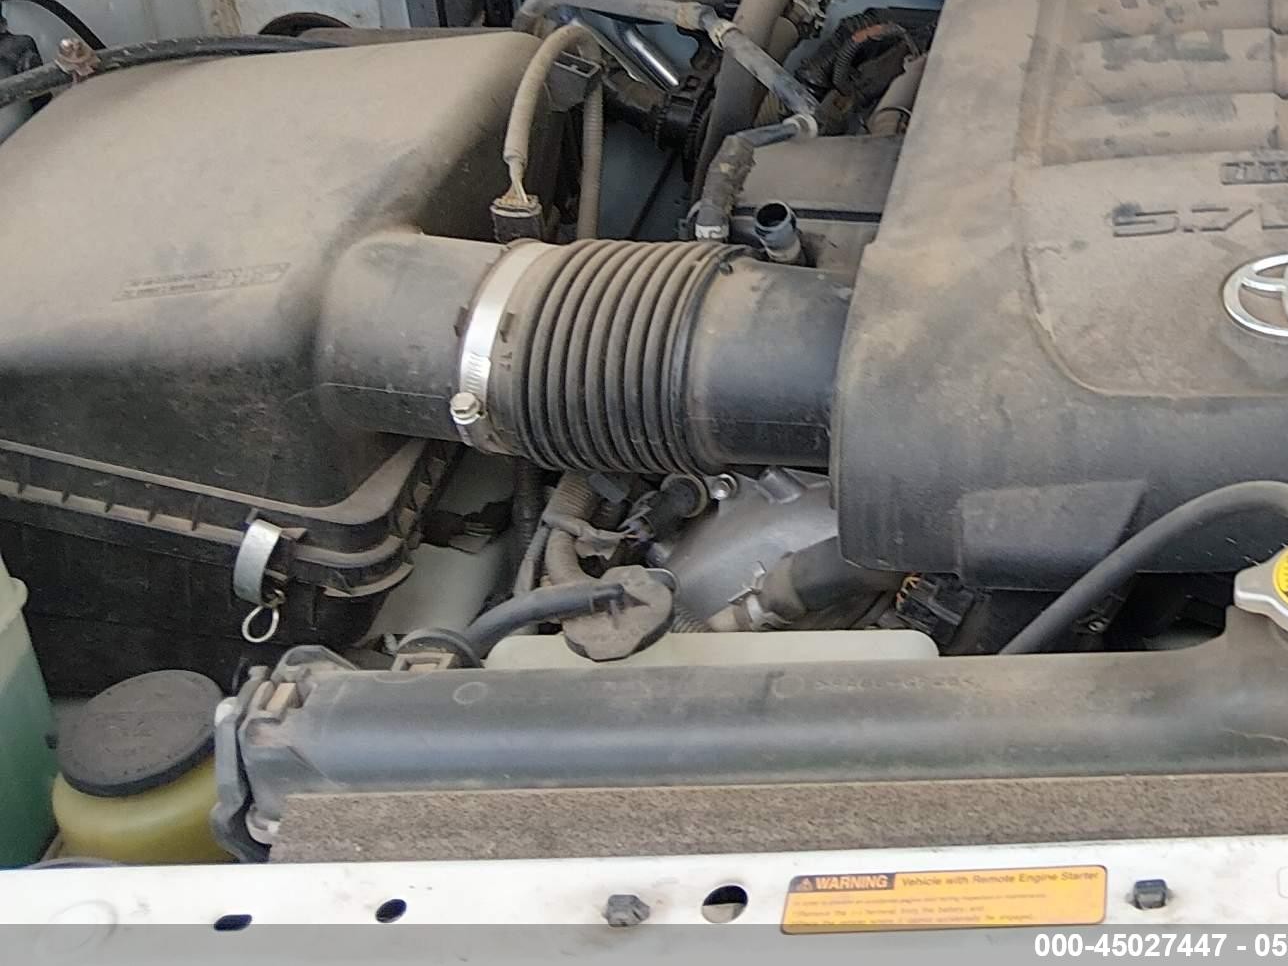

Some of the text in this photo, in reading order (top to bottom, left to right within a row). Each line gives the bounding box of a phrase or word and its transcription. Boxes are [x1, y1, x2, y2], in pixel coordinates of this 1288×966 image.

[814, 875, 888, 890] WARNING
[901, 871, 1099, 888] Vehicle with Remote Engine Starter
